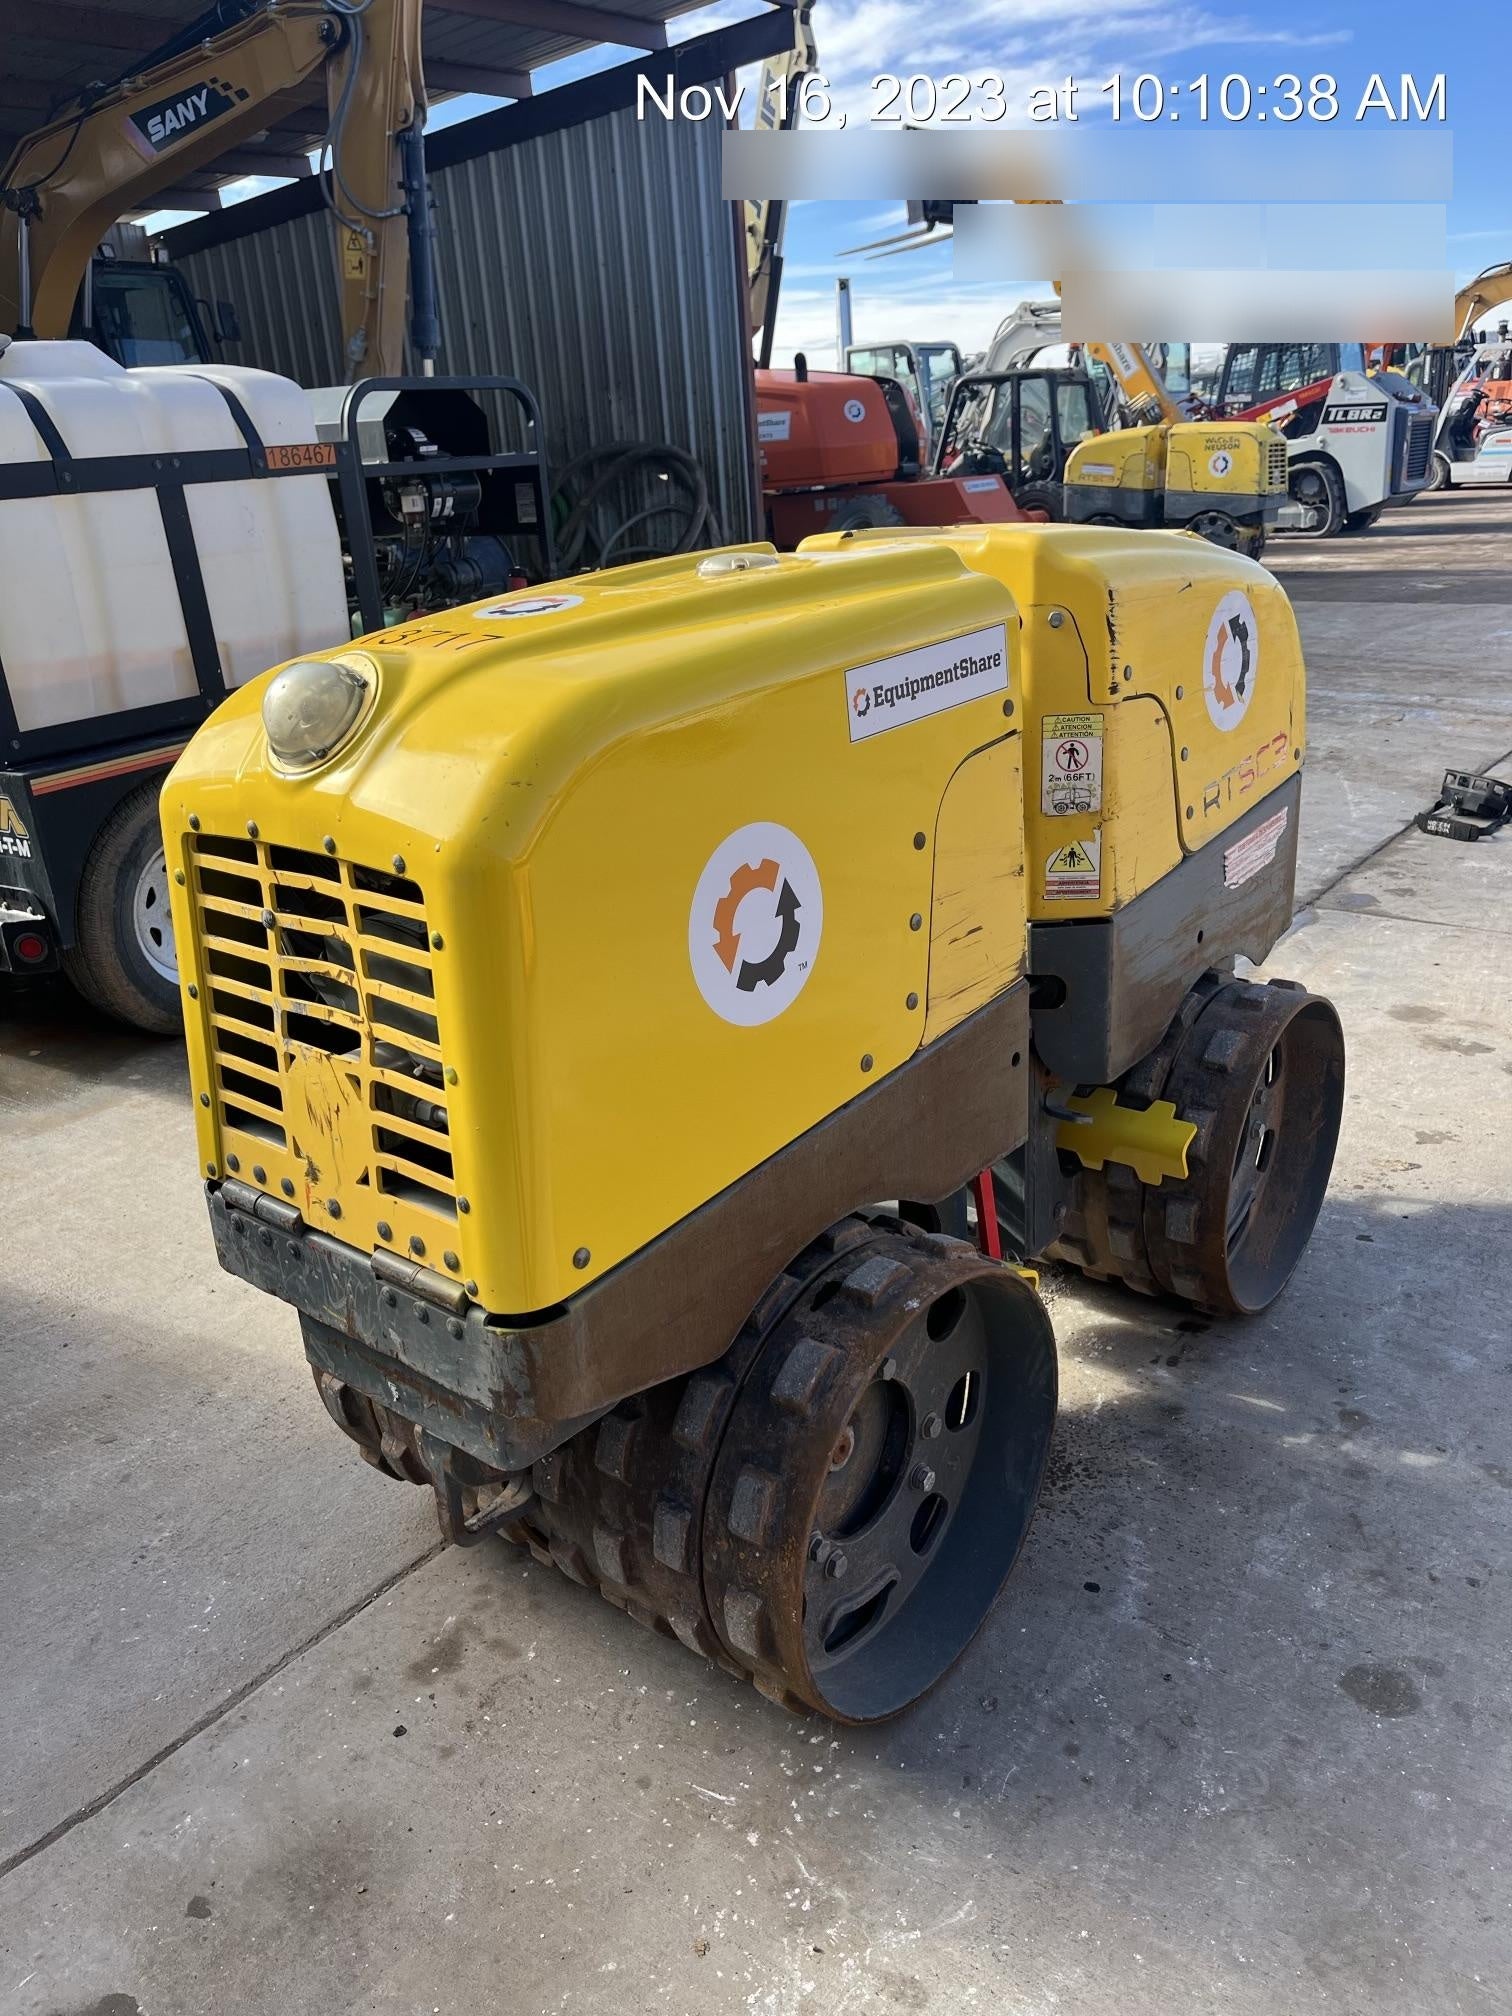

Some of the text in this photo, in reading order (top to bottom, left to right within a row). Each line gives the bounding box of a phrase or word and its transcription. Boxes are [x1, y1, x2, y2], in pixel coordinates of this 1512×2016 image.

[147, 88, 208, 143] SANY
[269, 444, 332, 467] 186467
[872, 651, 1002, 708] EquipmentShare
